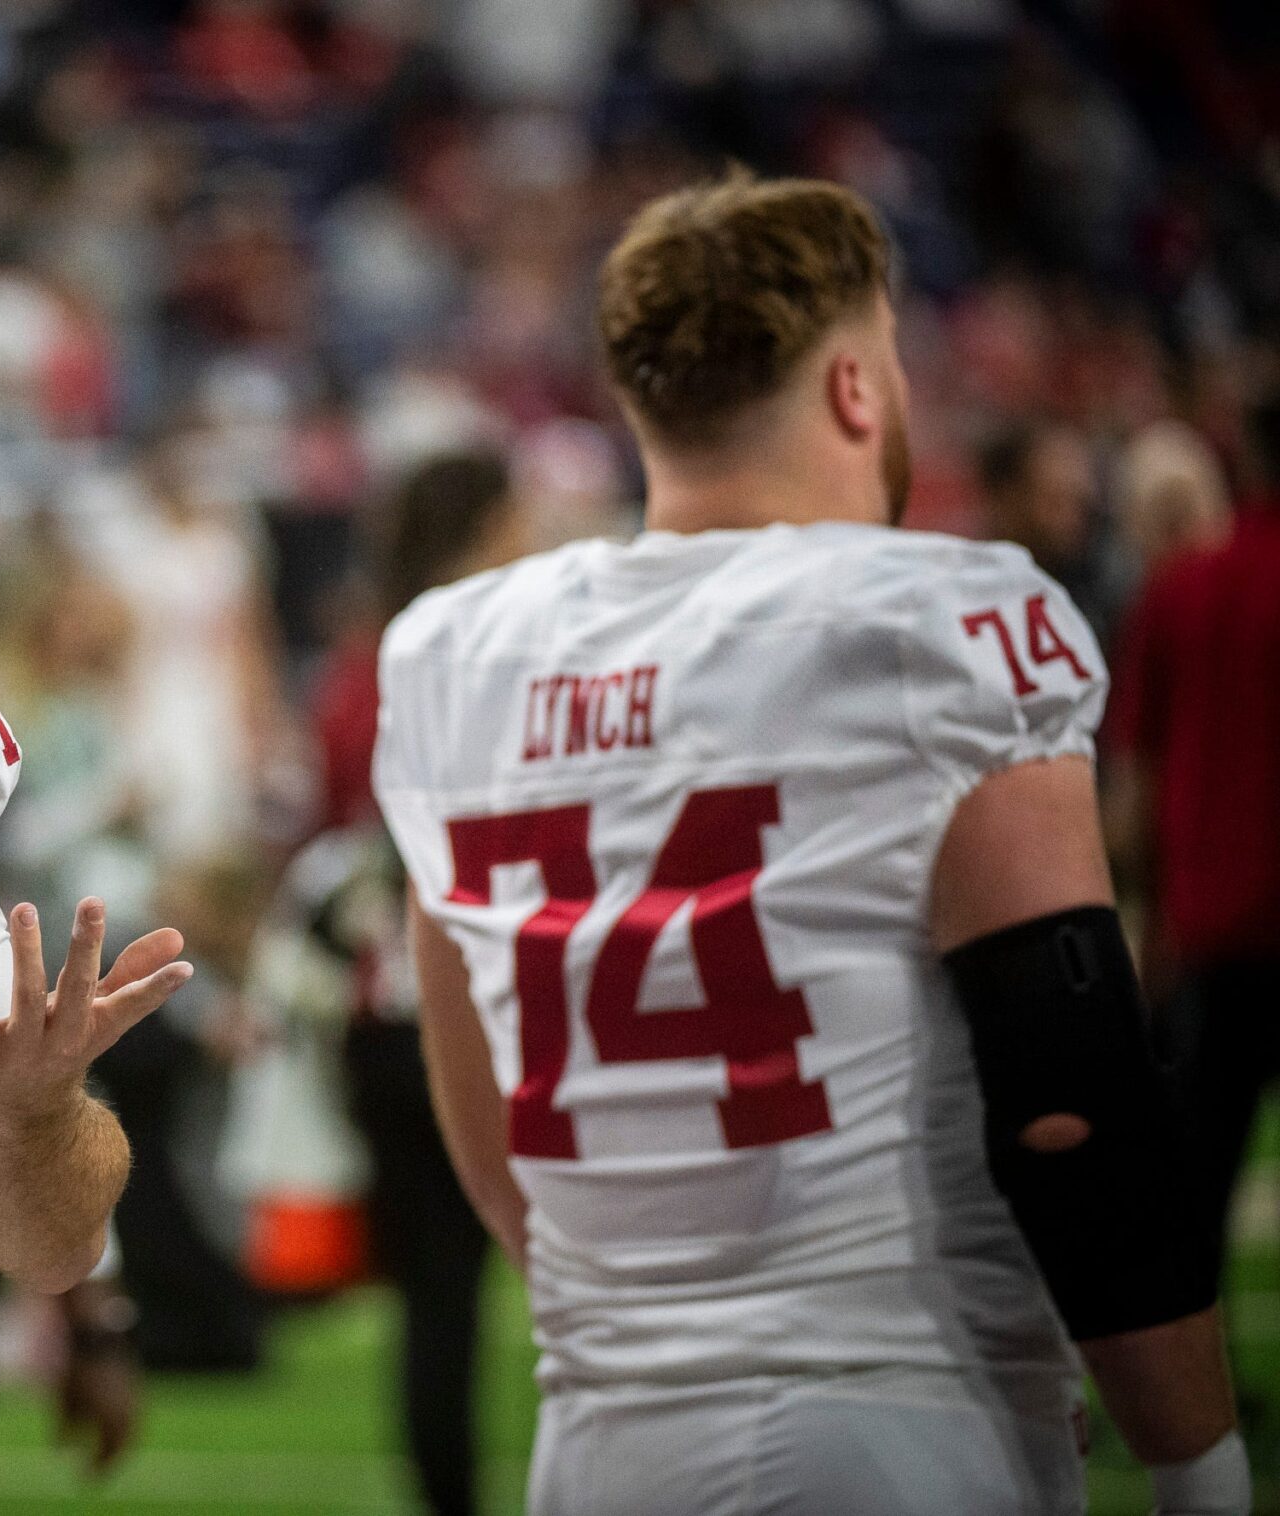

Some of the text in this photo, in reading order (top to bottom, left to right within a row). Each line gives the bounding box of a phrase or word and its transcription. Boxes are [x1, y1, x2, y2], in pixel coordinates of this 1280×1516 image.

[961, 594, 1091, 697] 74
[522, 665, 660, 762] LYNCH
[445, 784, 833, 1160] 74
